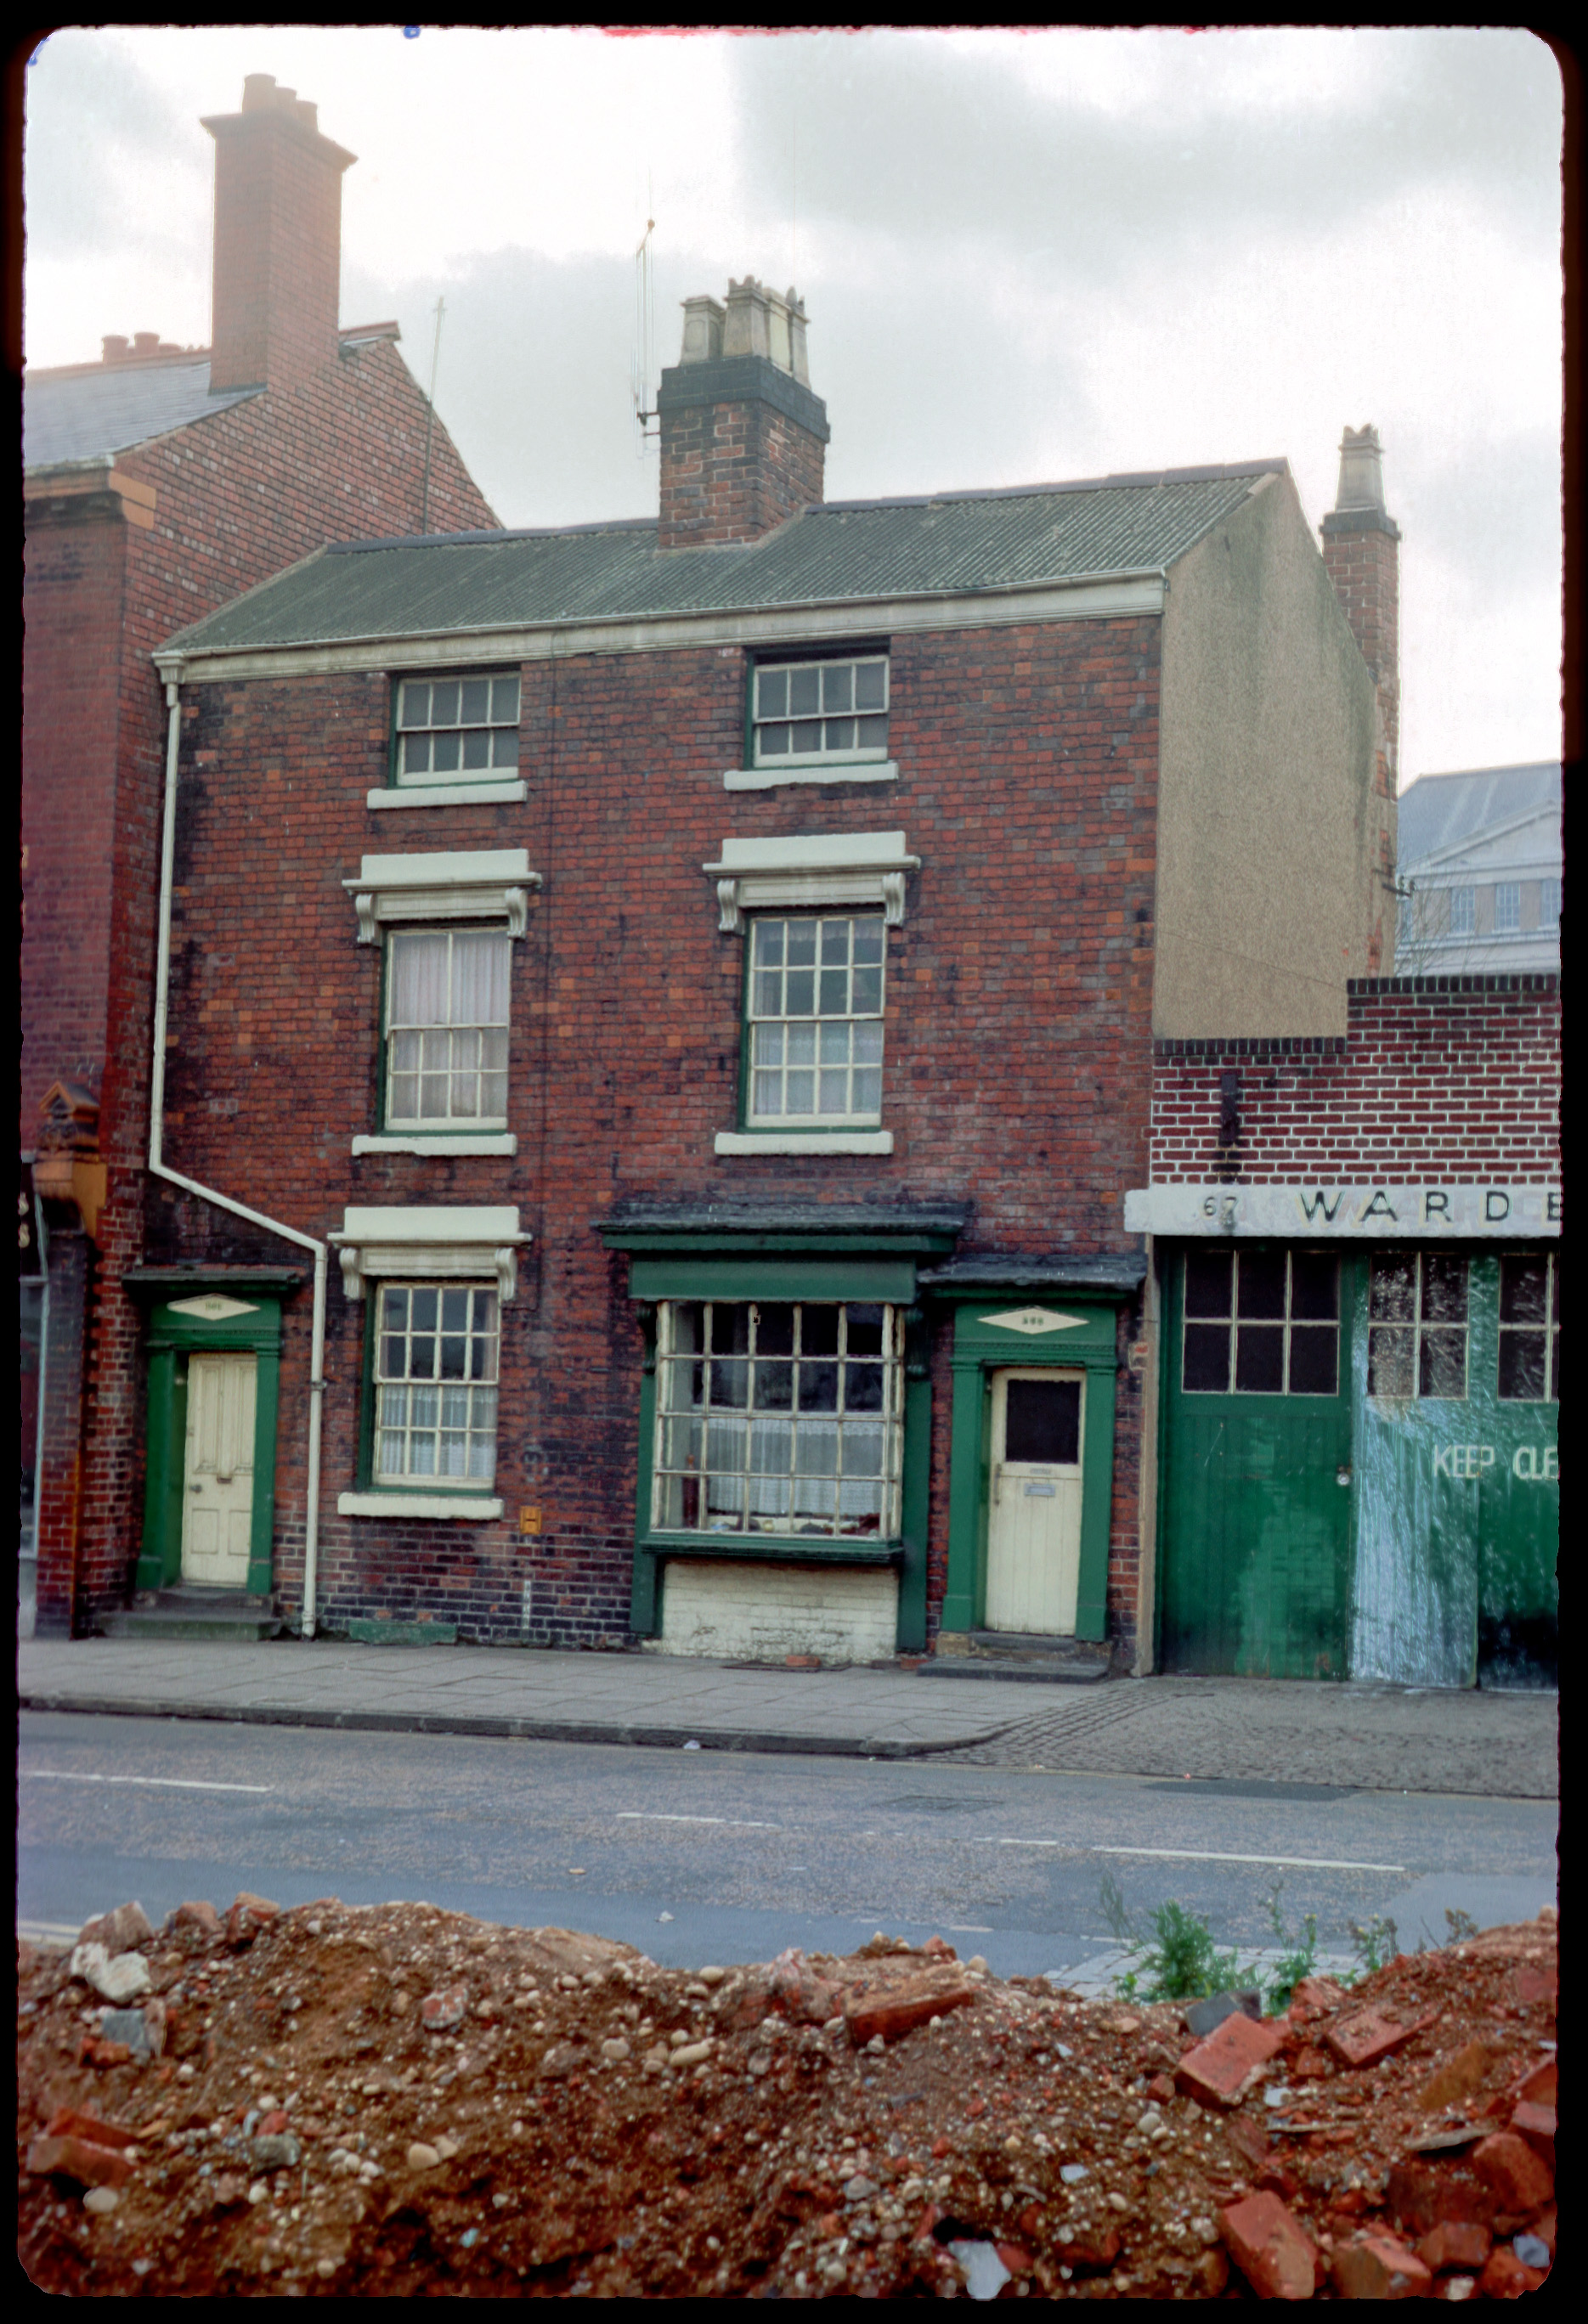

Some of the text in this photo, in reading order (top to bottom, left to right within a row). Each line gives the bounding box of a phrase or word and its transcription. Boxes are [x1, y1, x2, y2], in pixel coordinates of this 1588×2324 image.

[1203, 1191, 1560, 1222] 67 WARDE
[1433, 1445, 1559, 1481] KEEP CLE
